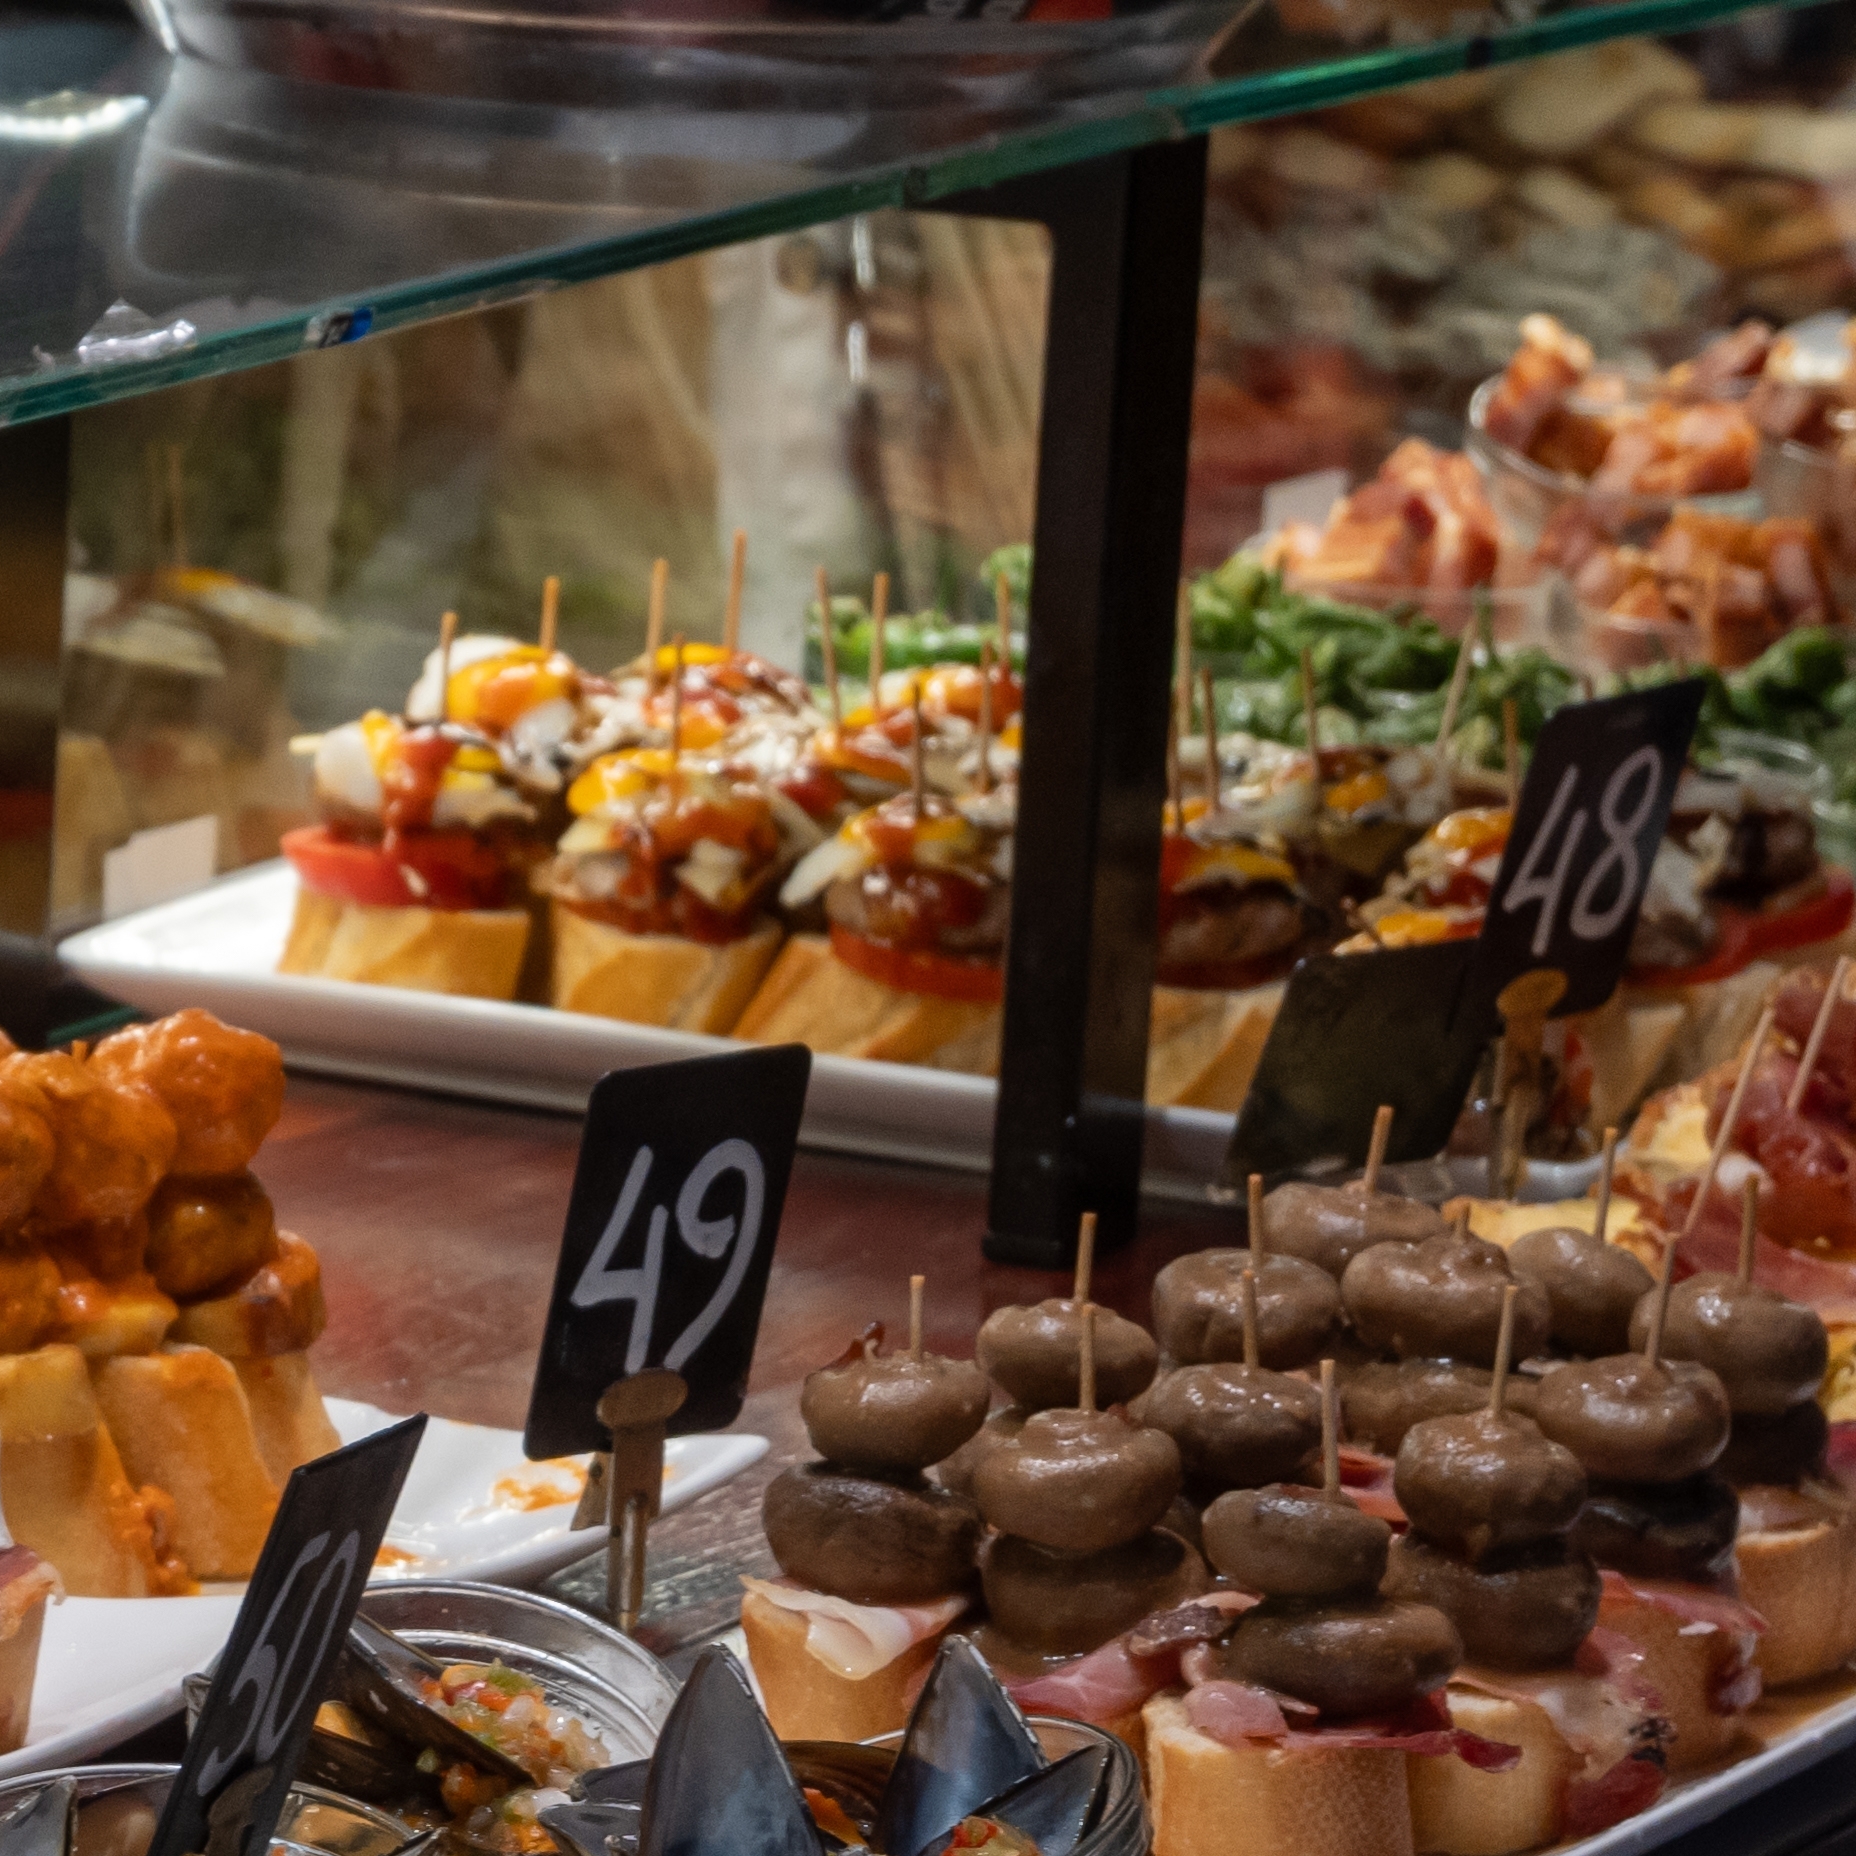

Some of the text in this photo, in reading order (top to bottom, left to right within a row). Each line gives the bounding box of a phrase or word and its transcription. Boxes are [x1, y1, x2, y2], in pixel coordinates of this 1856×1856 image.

[1503, 744, 1663, 956] 48
[570, 1138, 766, 1374] 49
[197, 1530, 360, 1796] 50
